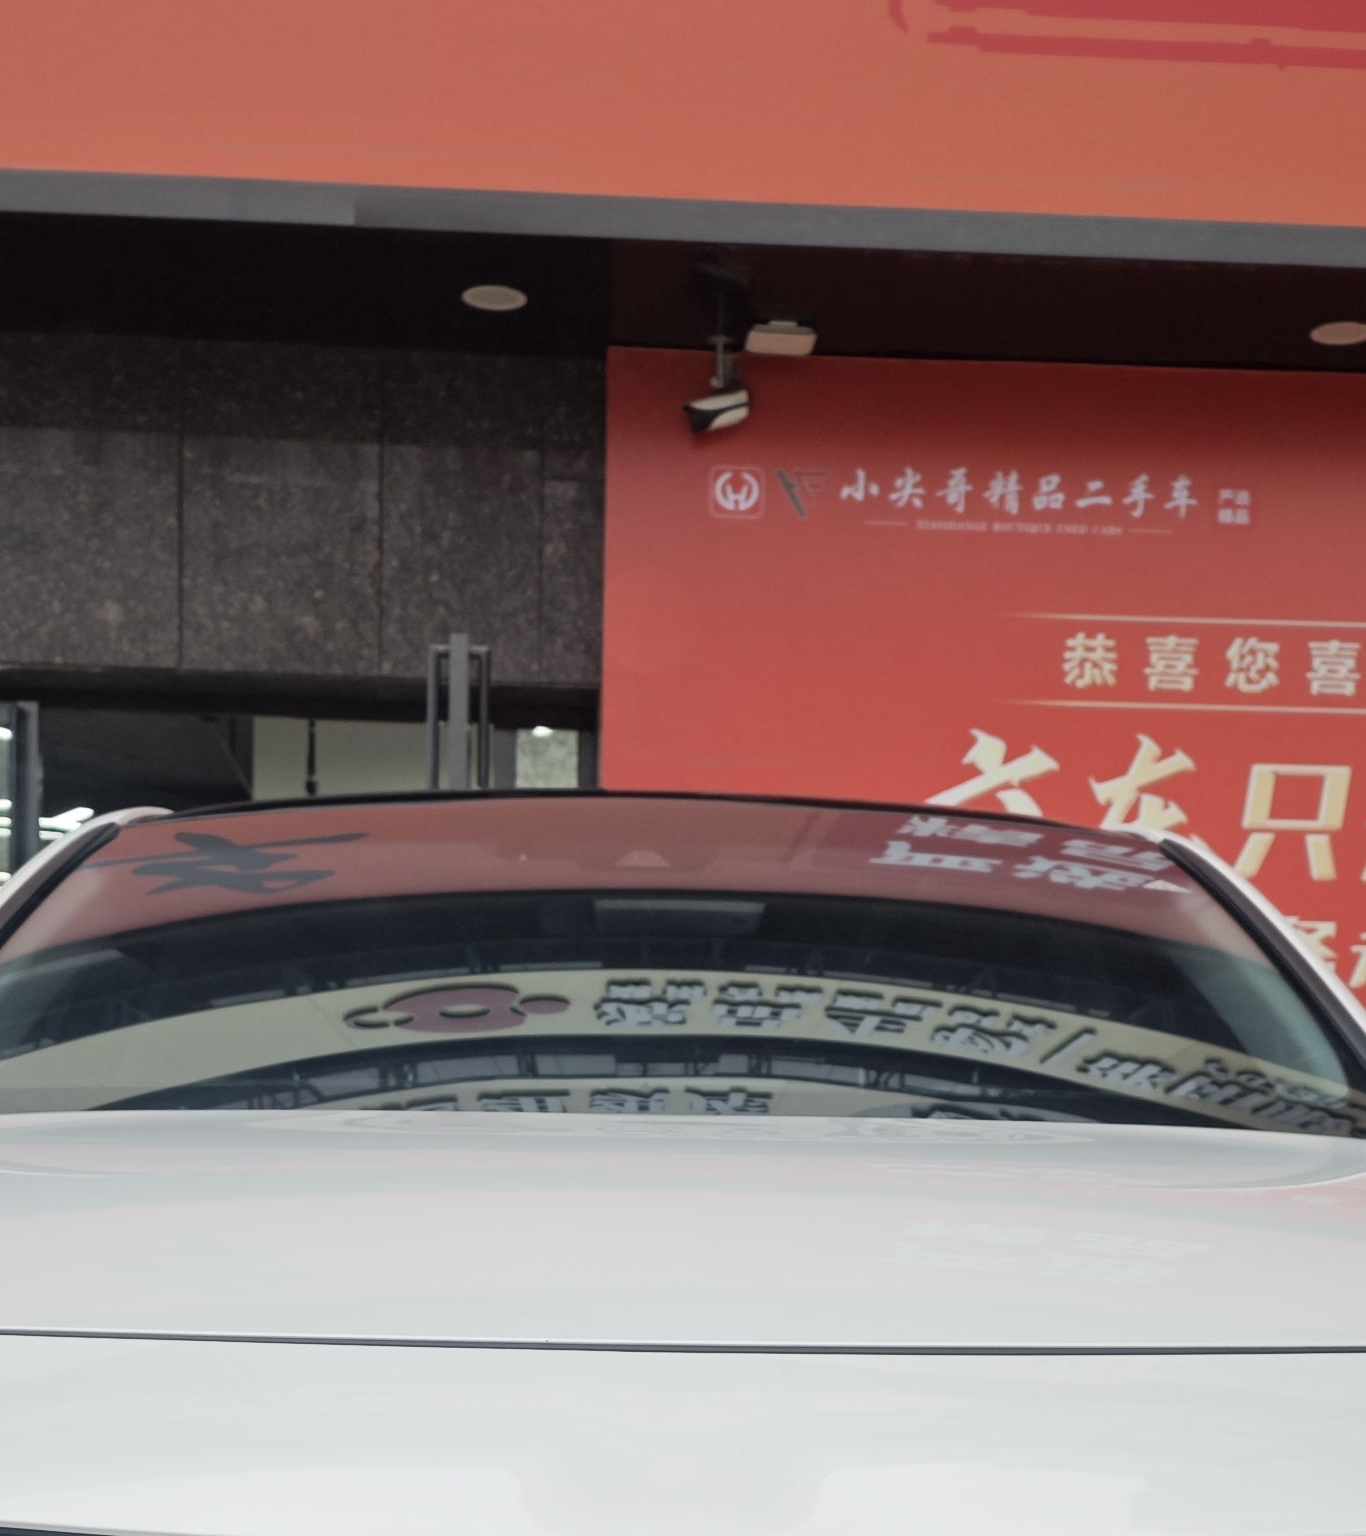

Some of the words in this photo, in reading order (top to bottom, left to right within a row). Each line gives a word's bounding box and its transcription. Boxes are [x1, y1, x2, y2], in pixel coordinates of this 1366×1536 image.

[839, 466, 1198, 519] 小尖哥精品二手车
